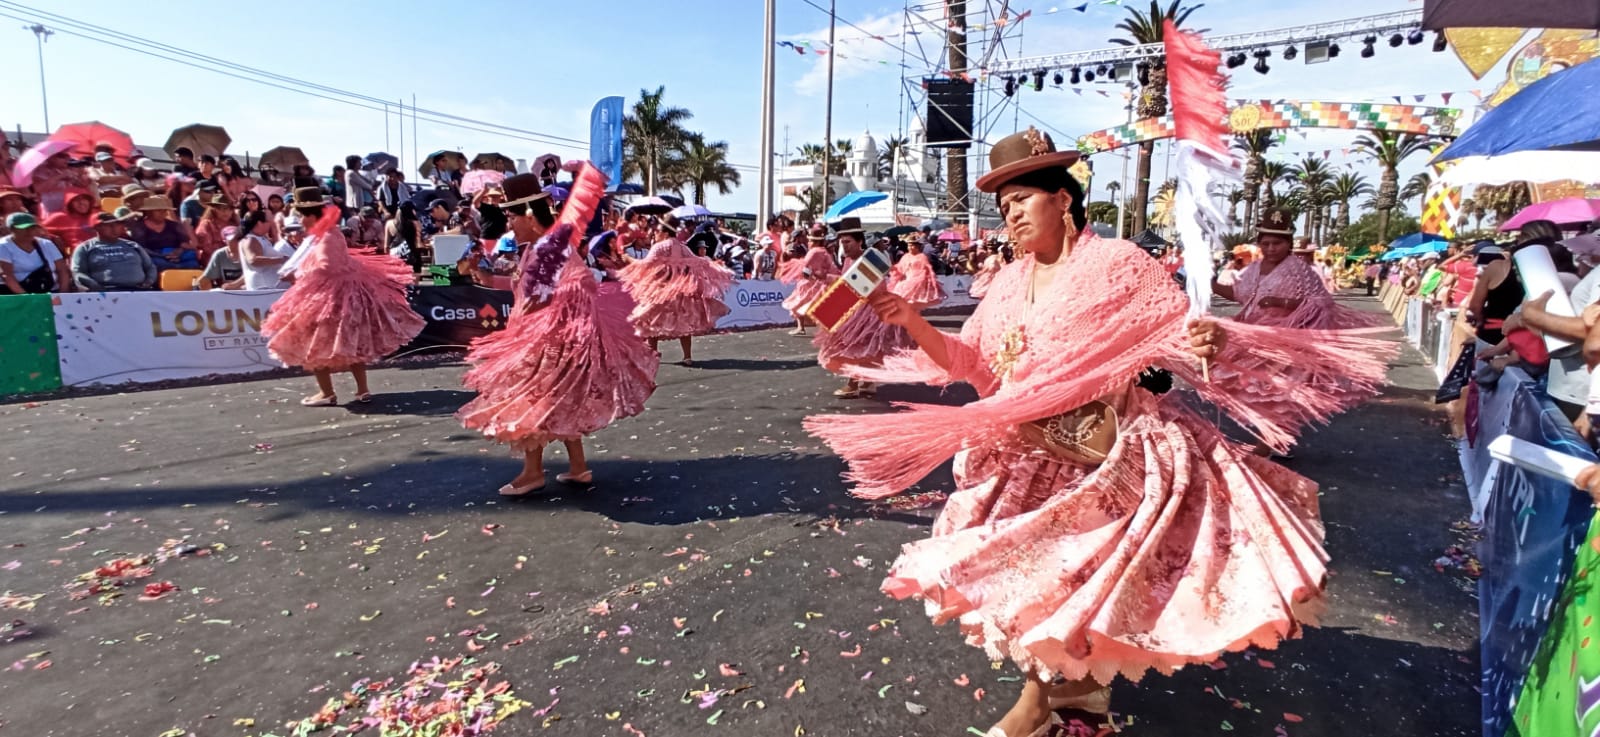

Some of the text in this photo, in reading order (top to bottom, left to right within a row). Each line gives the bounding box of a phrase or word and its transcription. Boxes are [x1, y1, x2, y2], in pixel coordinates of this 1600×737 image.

[751, 292, 784, 301] ACIRA
[431, 305, 476, 321] Casa
[150, 308, 272, 338] LOUN
[208, 339, 225, 348] BY
